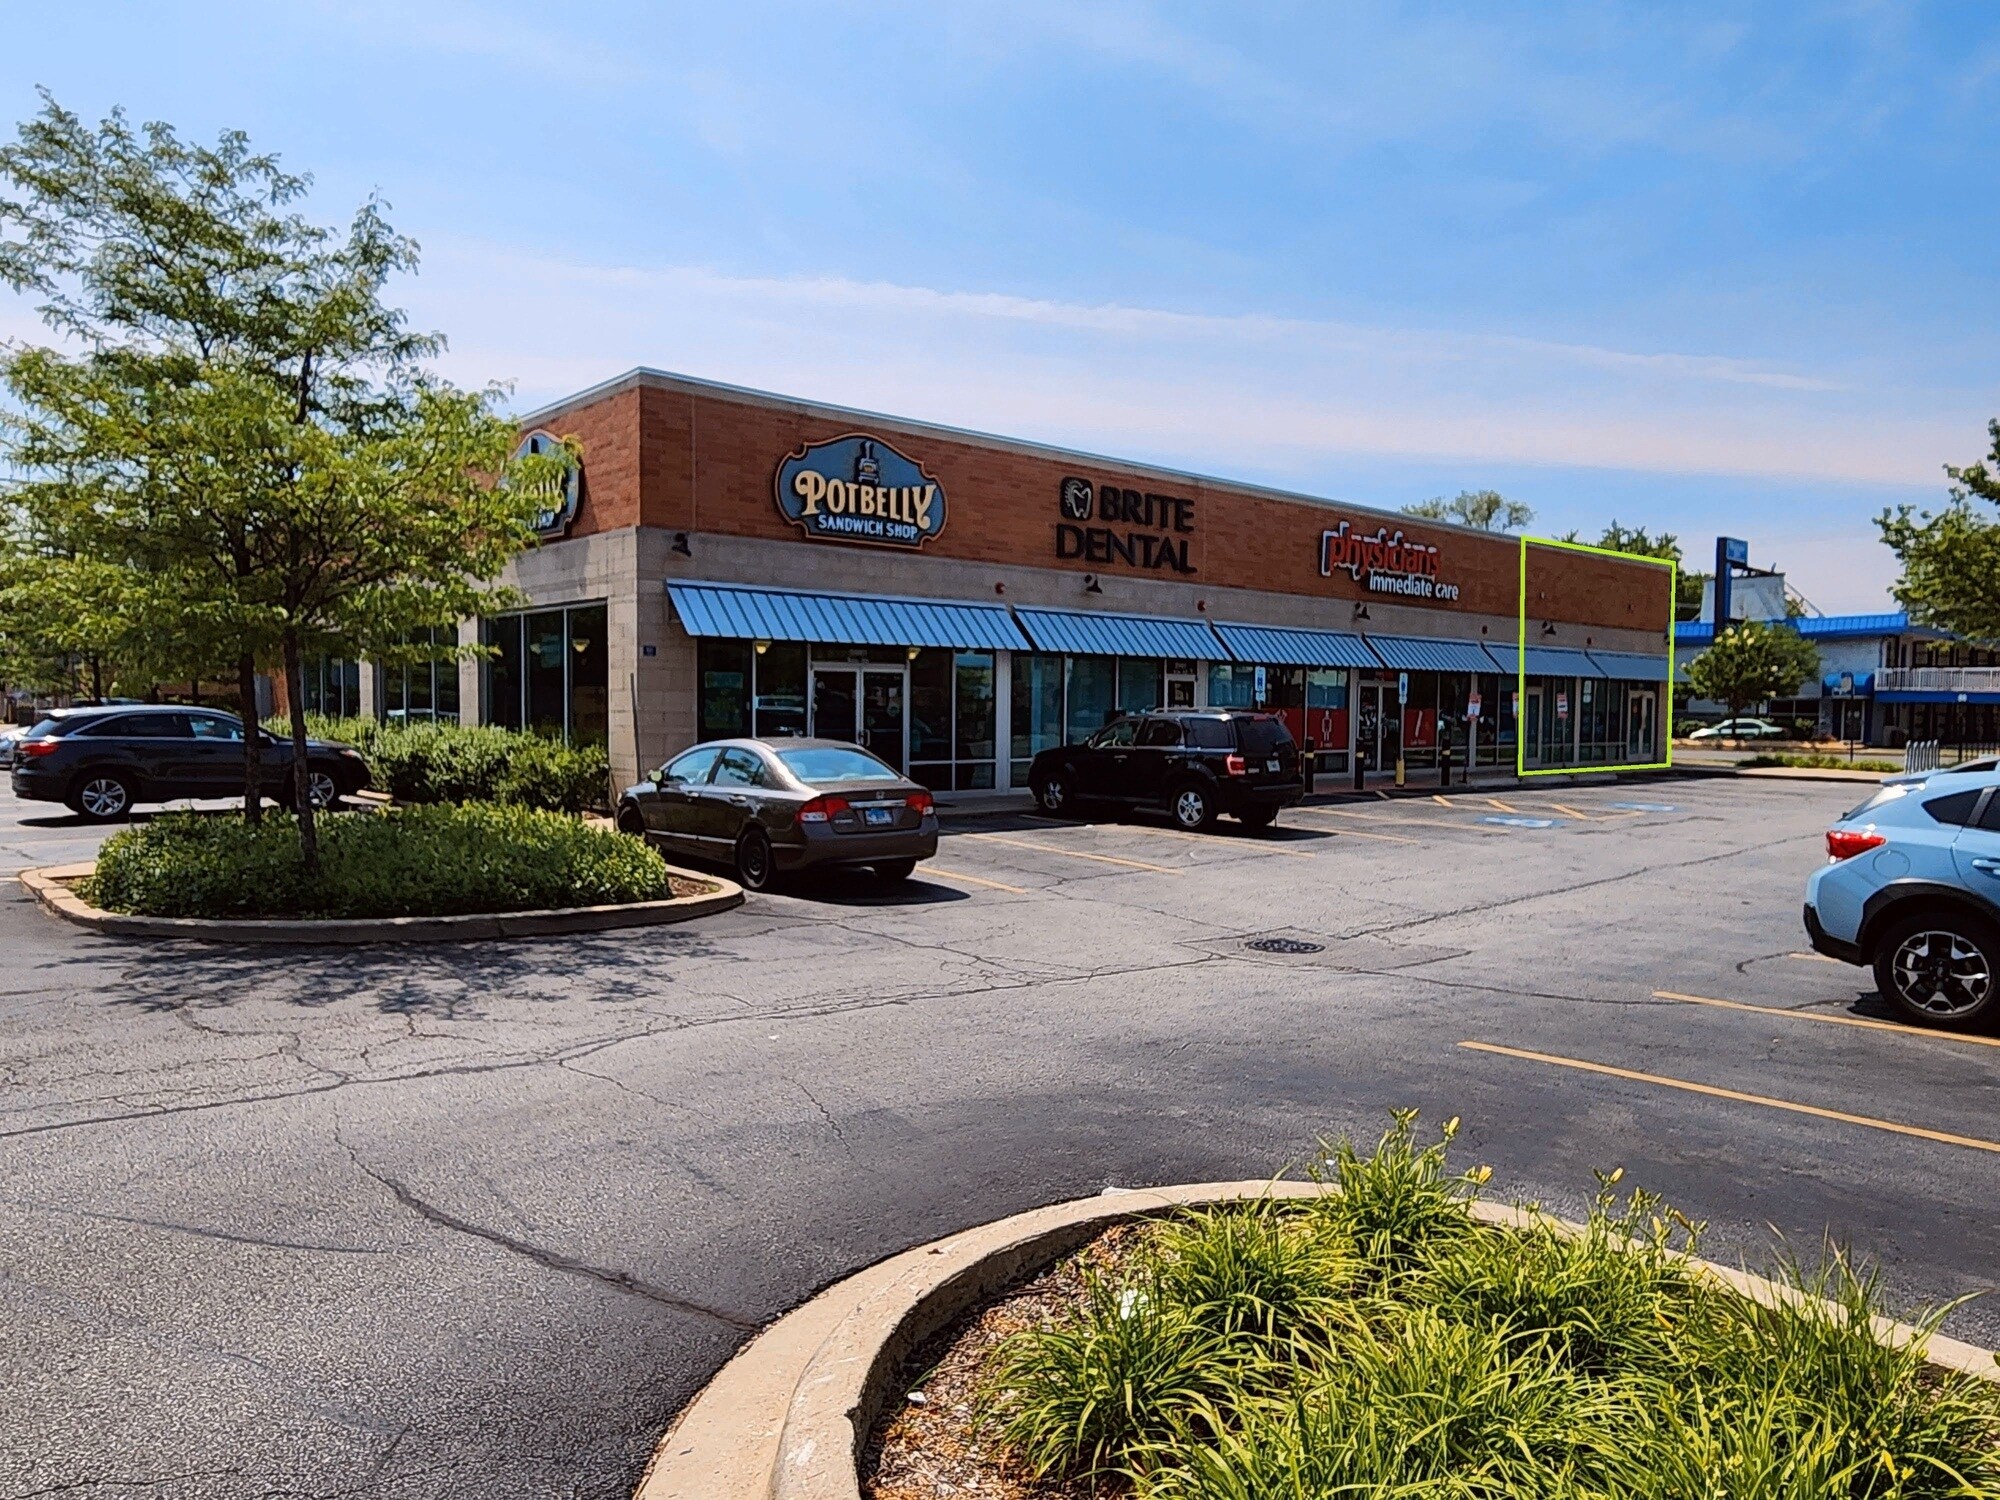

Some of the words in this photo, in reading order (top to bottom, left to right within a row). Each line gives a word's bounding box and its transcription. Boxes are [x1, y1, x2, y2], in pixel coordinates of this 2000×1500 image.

[818, 515, 885, 537] SANDWICH
[886, 522, 918, 540] SHOP
[1099, 485, 1196, 533] BRITE
[1055, 523, 1198, 574] DENTAL
[1328, 523, 1442, 577] physicians
[1435, 582, 1460, 600] care
